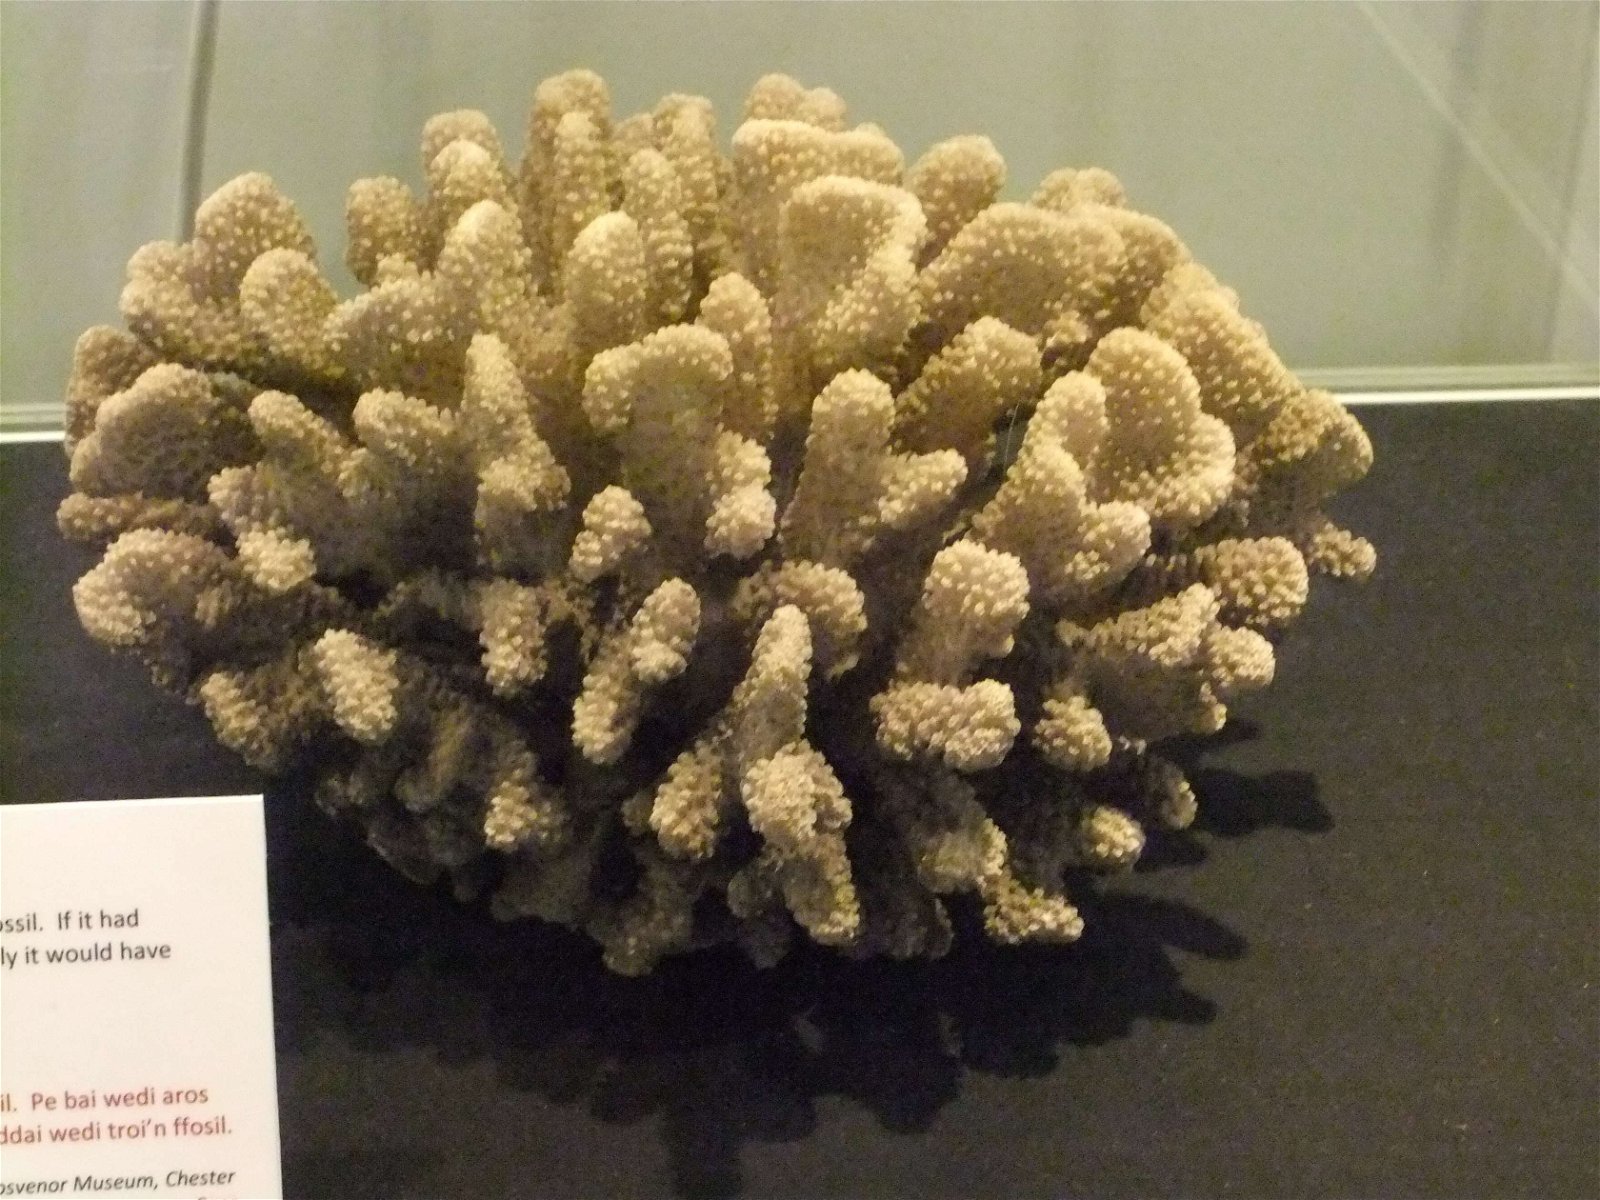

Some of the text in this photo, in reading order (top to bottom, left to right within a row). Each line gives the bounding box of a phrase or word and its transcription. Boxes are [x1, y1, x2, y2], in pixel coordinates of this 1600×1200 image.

[0, 908, 140, 933] ssil. If it had
[0, 941, 172, 970] ly it would have
[1, 1087, 209, 1112] il. Pe bai wedi aros
[49, 1122, 101, 1143] wedi
[107, 1119, 166, 1140] troi’n
[173, 1115, 233, 1137] ffosil.
[73, 1174, 158, 1193] Museum,
[165, 1169, 236, 1188] Chester
